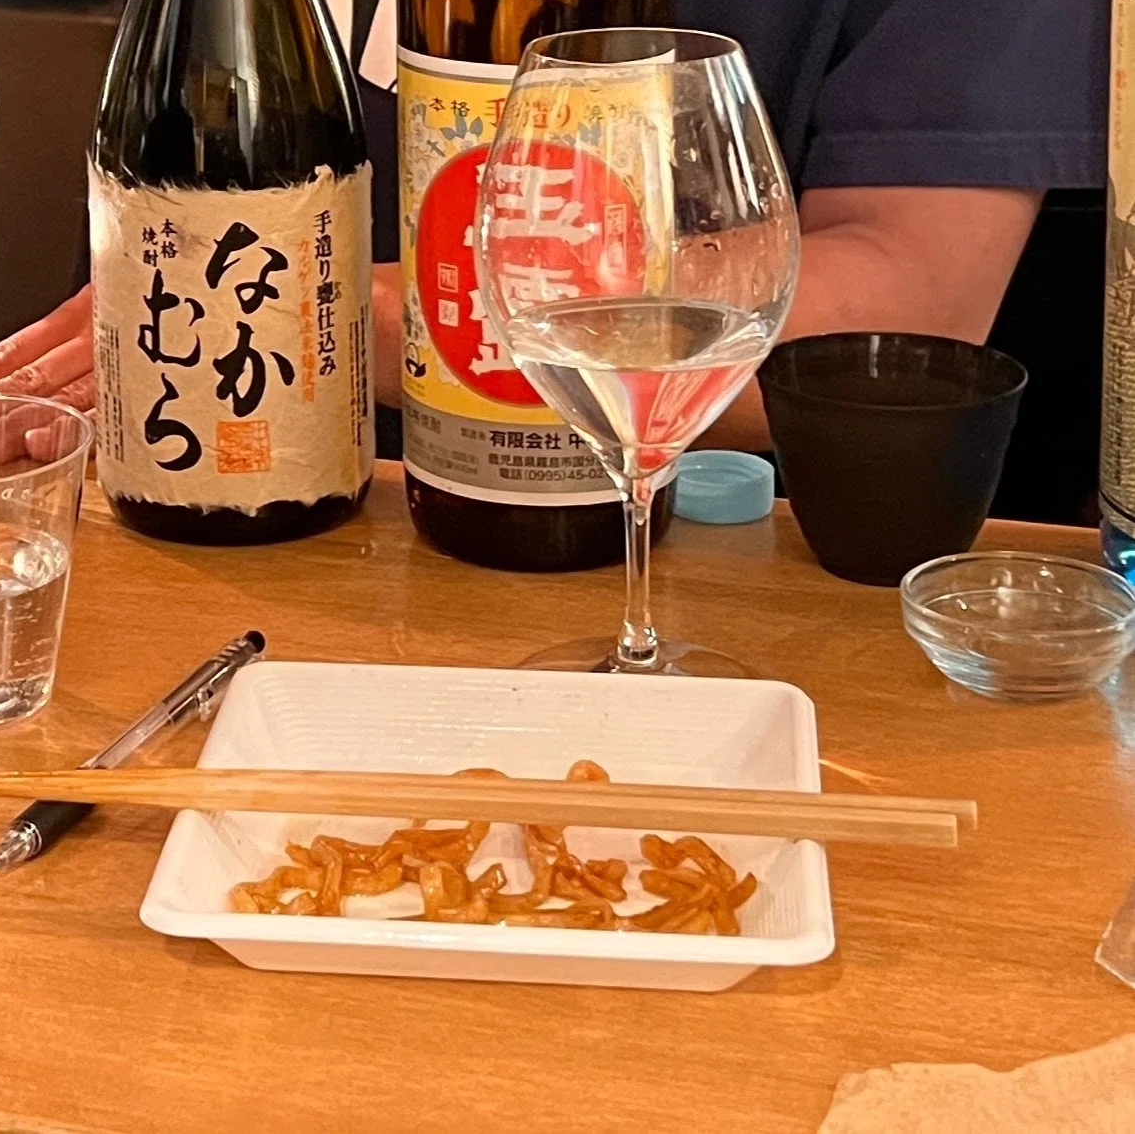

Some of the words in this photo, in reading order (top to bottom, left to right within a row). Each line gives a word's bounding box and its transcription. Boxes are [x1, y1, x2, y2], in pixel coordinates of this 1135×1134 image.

[429, 97, 471, 117] 本格
[142, 227, 159, 267] 焼酎
[160, 218, 179, 259] 本格
[489, 430, 562, 450] 有限会社
[487, 453, 599, 468] 鹿児島県霧島市国分
[499, 467, 607, 482] 電話(0995)45-02
